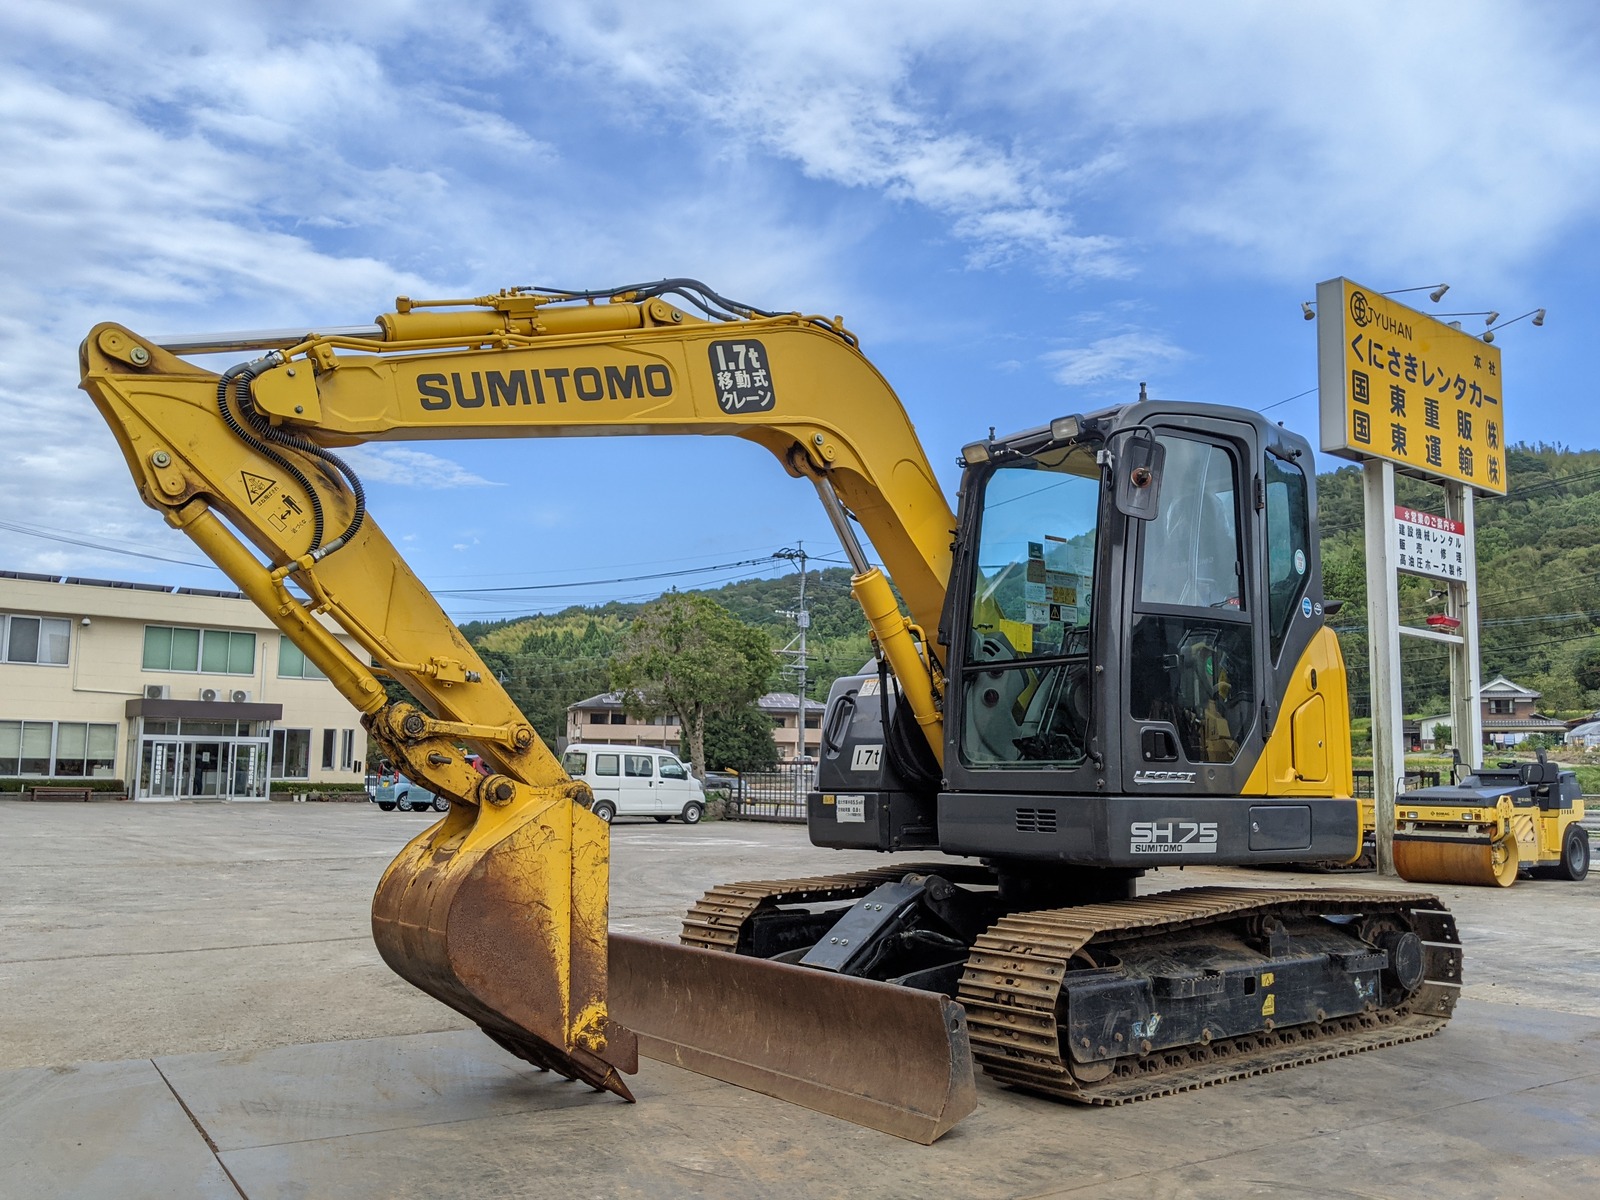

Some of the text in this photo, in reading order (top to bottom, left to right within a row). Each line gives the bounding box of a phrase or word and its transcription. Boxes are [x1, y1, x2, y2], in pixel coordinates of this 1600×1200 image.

[1366, 306, 1412, 341] JYUHAN
[716, 344, 761, 370] 1.7t
[1473, 354, 1496, 376] 本社
[716, 369, 769, 390] 移動式
[1351, 333, 1498, 408] くにさきレンタカー
[416, 363, 673, 411] SUMITOMO
[721, 390, 772, 410] クレーン
[1133, 770, 1196, 781] LEGEST
[1135, 844, 1183, 853] SUMITOMO
